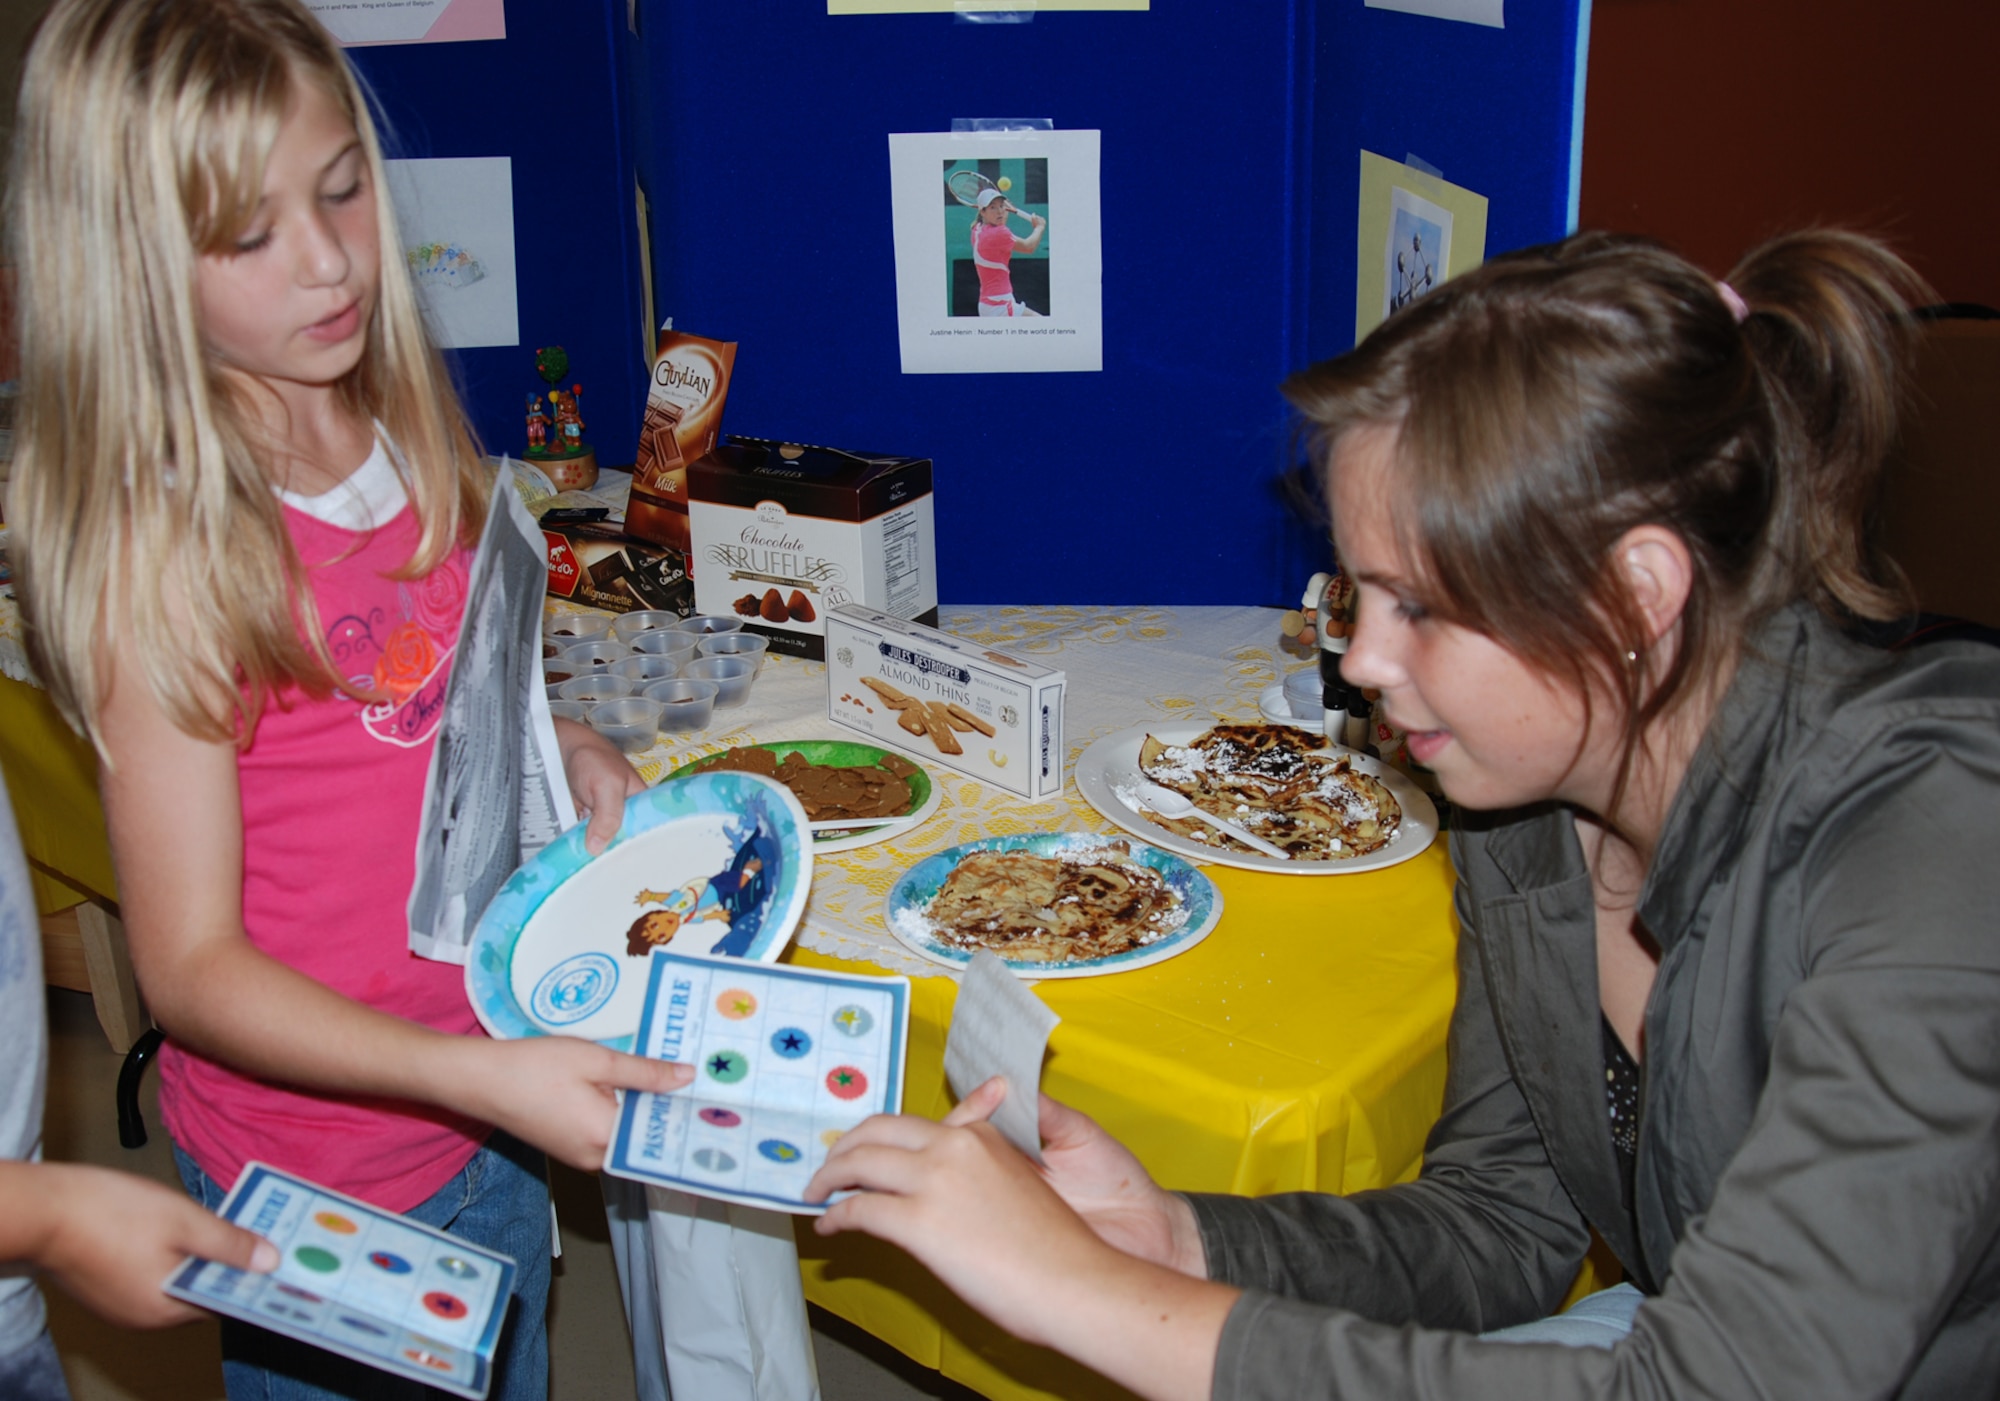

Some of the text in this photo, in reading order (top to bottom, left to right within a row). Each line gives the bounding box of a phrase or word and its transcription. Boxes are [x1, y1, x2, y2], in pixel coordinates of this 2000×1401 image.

[929, 328, 952, 336] Justine
[953, 328, 973, 336] Henin
[977, 328, 1003, 336] Number
[1030, 327, 1047, 335] world
[1056, 327, 1076, 335] tennis
[654, 474, 678, 494] Milk
[740, 525, 805, 552] Chocolate
[719, 543, 827, 582] TRUFFLES
[581, 584, 633, 607] Mignonnette
[827, 592, 848, 607] ALL
[888, 645, 961, 680] JULES DESTROOPER
[879, 663, 971, 706] ALMOND THINS
[660, 979, 692, 1061] ULTURE
